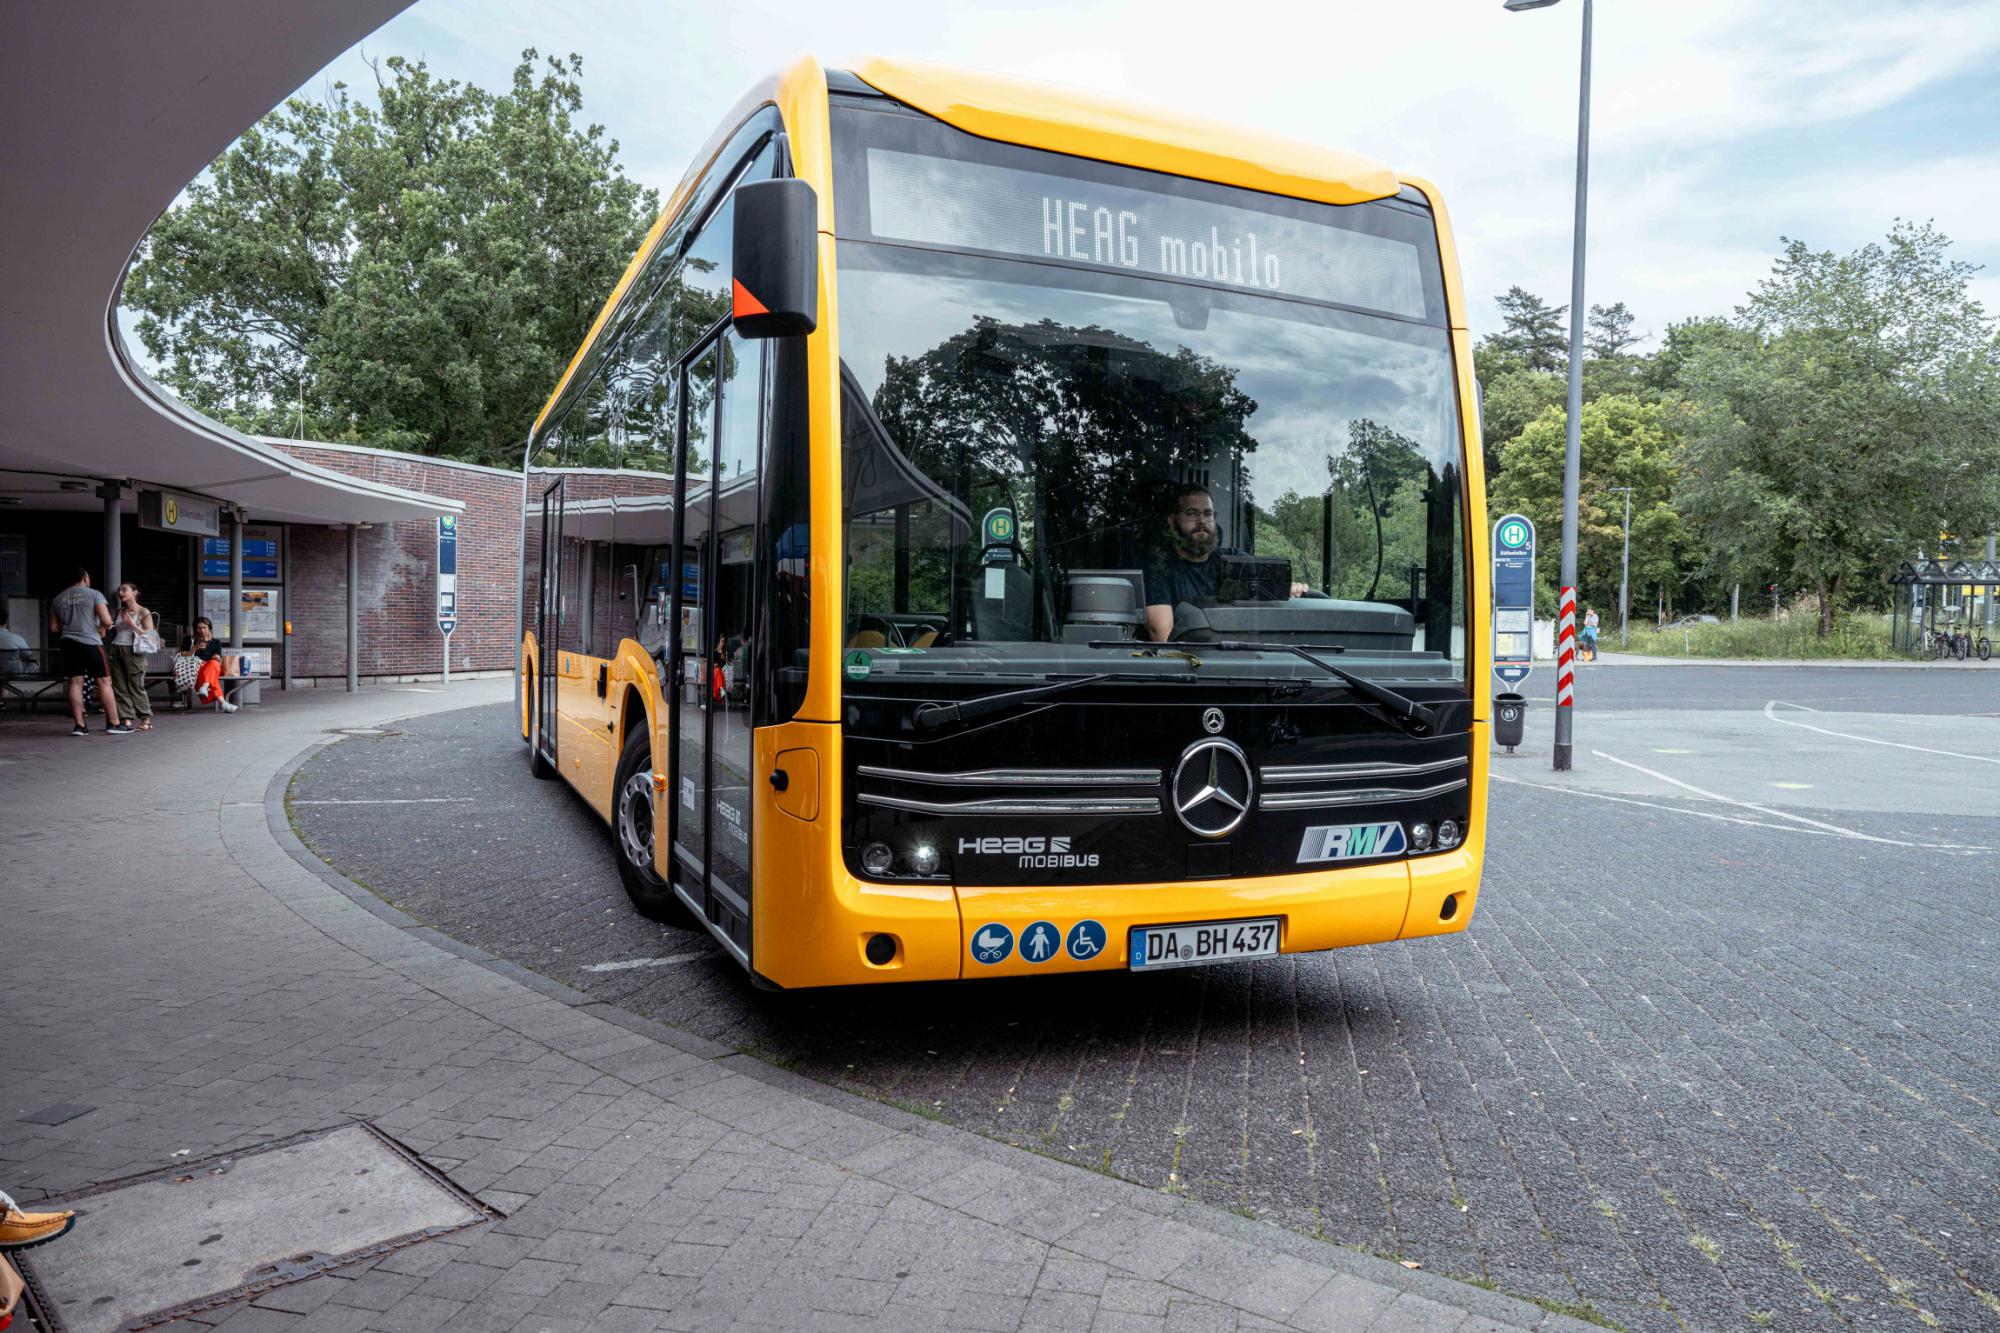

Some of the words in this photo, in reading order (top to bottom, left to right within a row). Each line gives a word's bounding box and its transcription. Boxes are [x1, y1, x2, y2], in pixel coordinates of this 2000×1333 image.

[1043, 197, 1138, 267] HEAG
[1160, 226, 1280, 289] mobilo
[1508, 527, 1520, 542] H
[1525, 541, 1532, 550] 5
[854, 652, 862, 666] 4
[1320, 824, 1398, 858] RMV
[1019, 854, 1100, 868] MOBIBUS
[1147, 932, 1179, 961] DA
[1196, 928, 1228, 956] BH
[1232, 924, 1276, 952] 437
[1135, 951, 1142, 960] D
